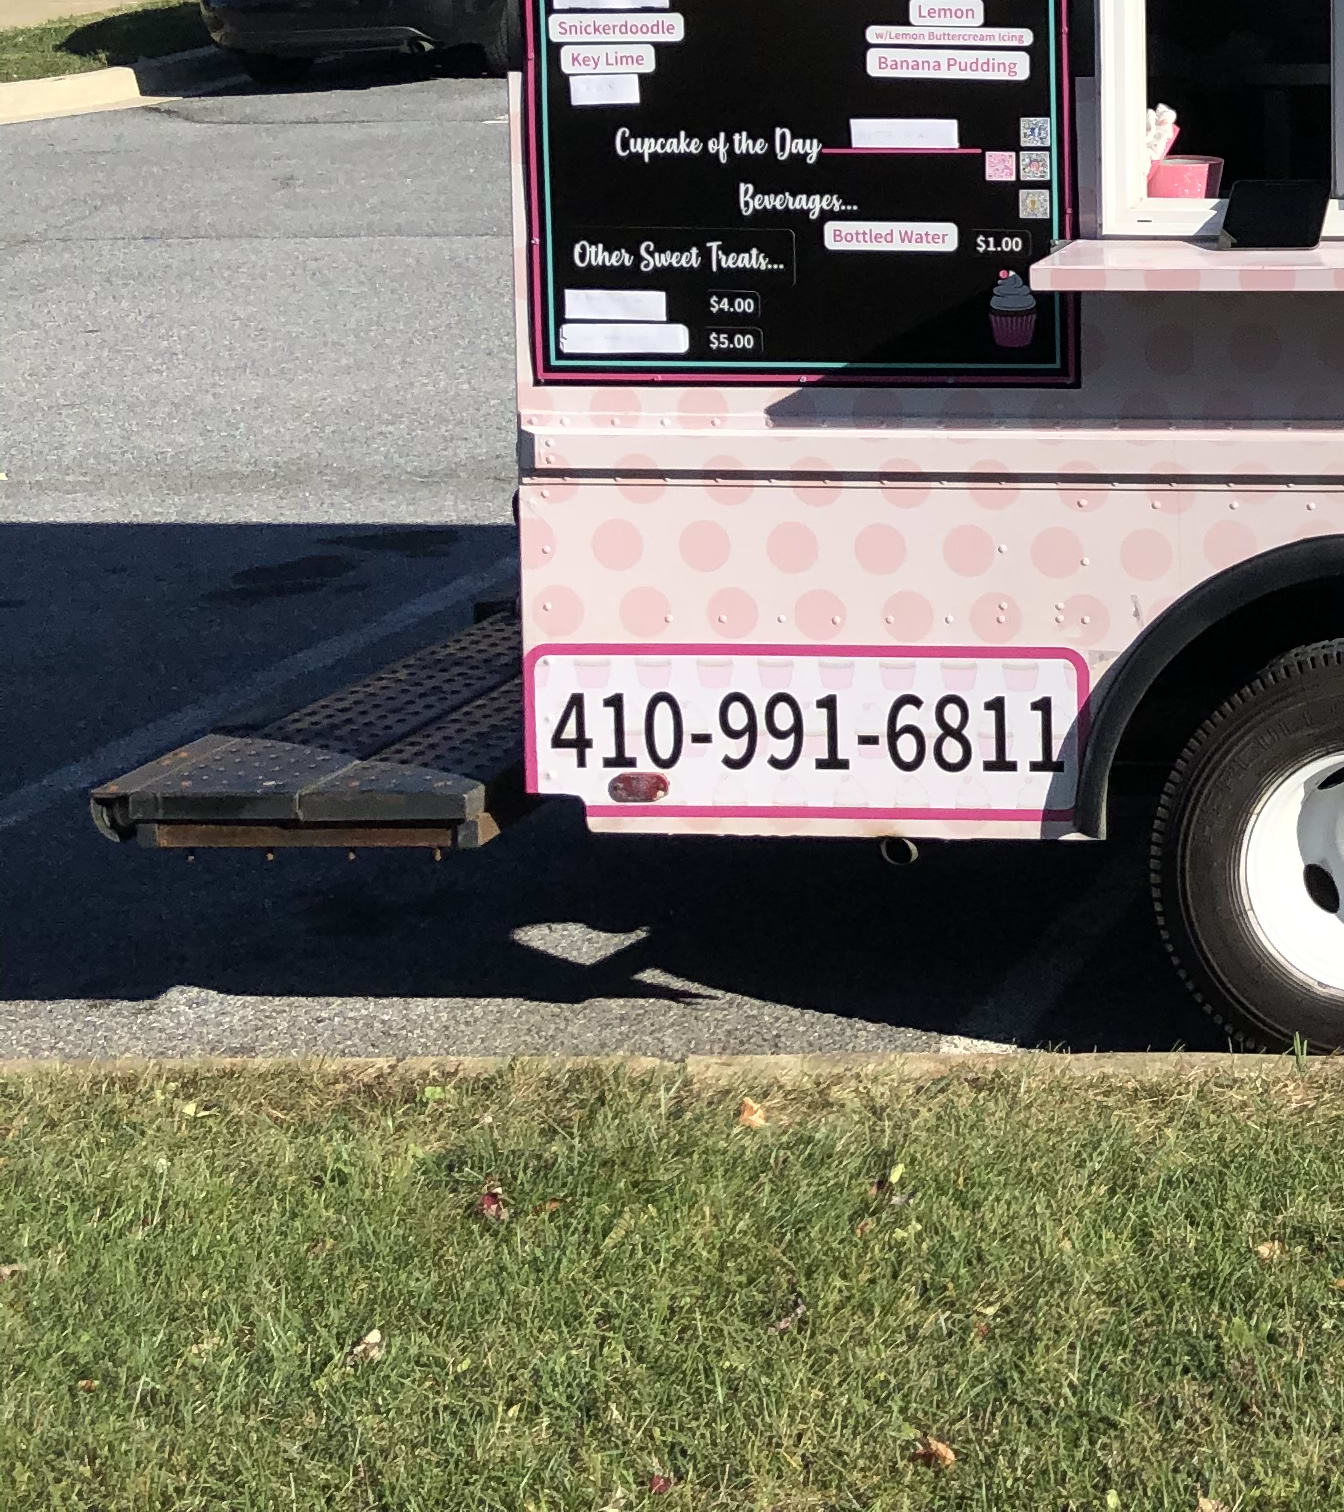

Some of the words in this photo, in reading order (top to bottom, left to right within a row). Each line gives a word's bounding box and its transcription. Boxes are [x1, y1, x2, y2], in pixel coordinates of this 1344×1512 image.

[917, 4, 975, 19] Lemon
[558, 20, 676, 35] Snickerdoodle
[874, 31, 926, 41] w/Lemon
[928, 31, 996, 42] Buttercream
[571, 52, 600, 70] Key
[605, 51, 645, 66] Lime
[878, 56, 942, 71] Banana
[946, 57, 1018, 76] Pudding
[615, 127, 703, 163] Cupcake
[708, 132, 729, 163] of
[733, 131, 768, 154] the
[774, 126, 822, 164] Day
[739, 182, 858, 219] Beverages...
[832, 228, 894, 244] Bottled
[899, 230, 949, 244] Water
[977, 235, 1021, 252] $1.00
[574, 241, 633, 267] Other
[640, 242, 701, 271] Sweet
[710, 296, 754, 313] $4.00
[710, 332, 753, 349] $5.00
[551, 691, 1065, 773] 410-991-6811
